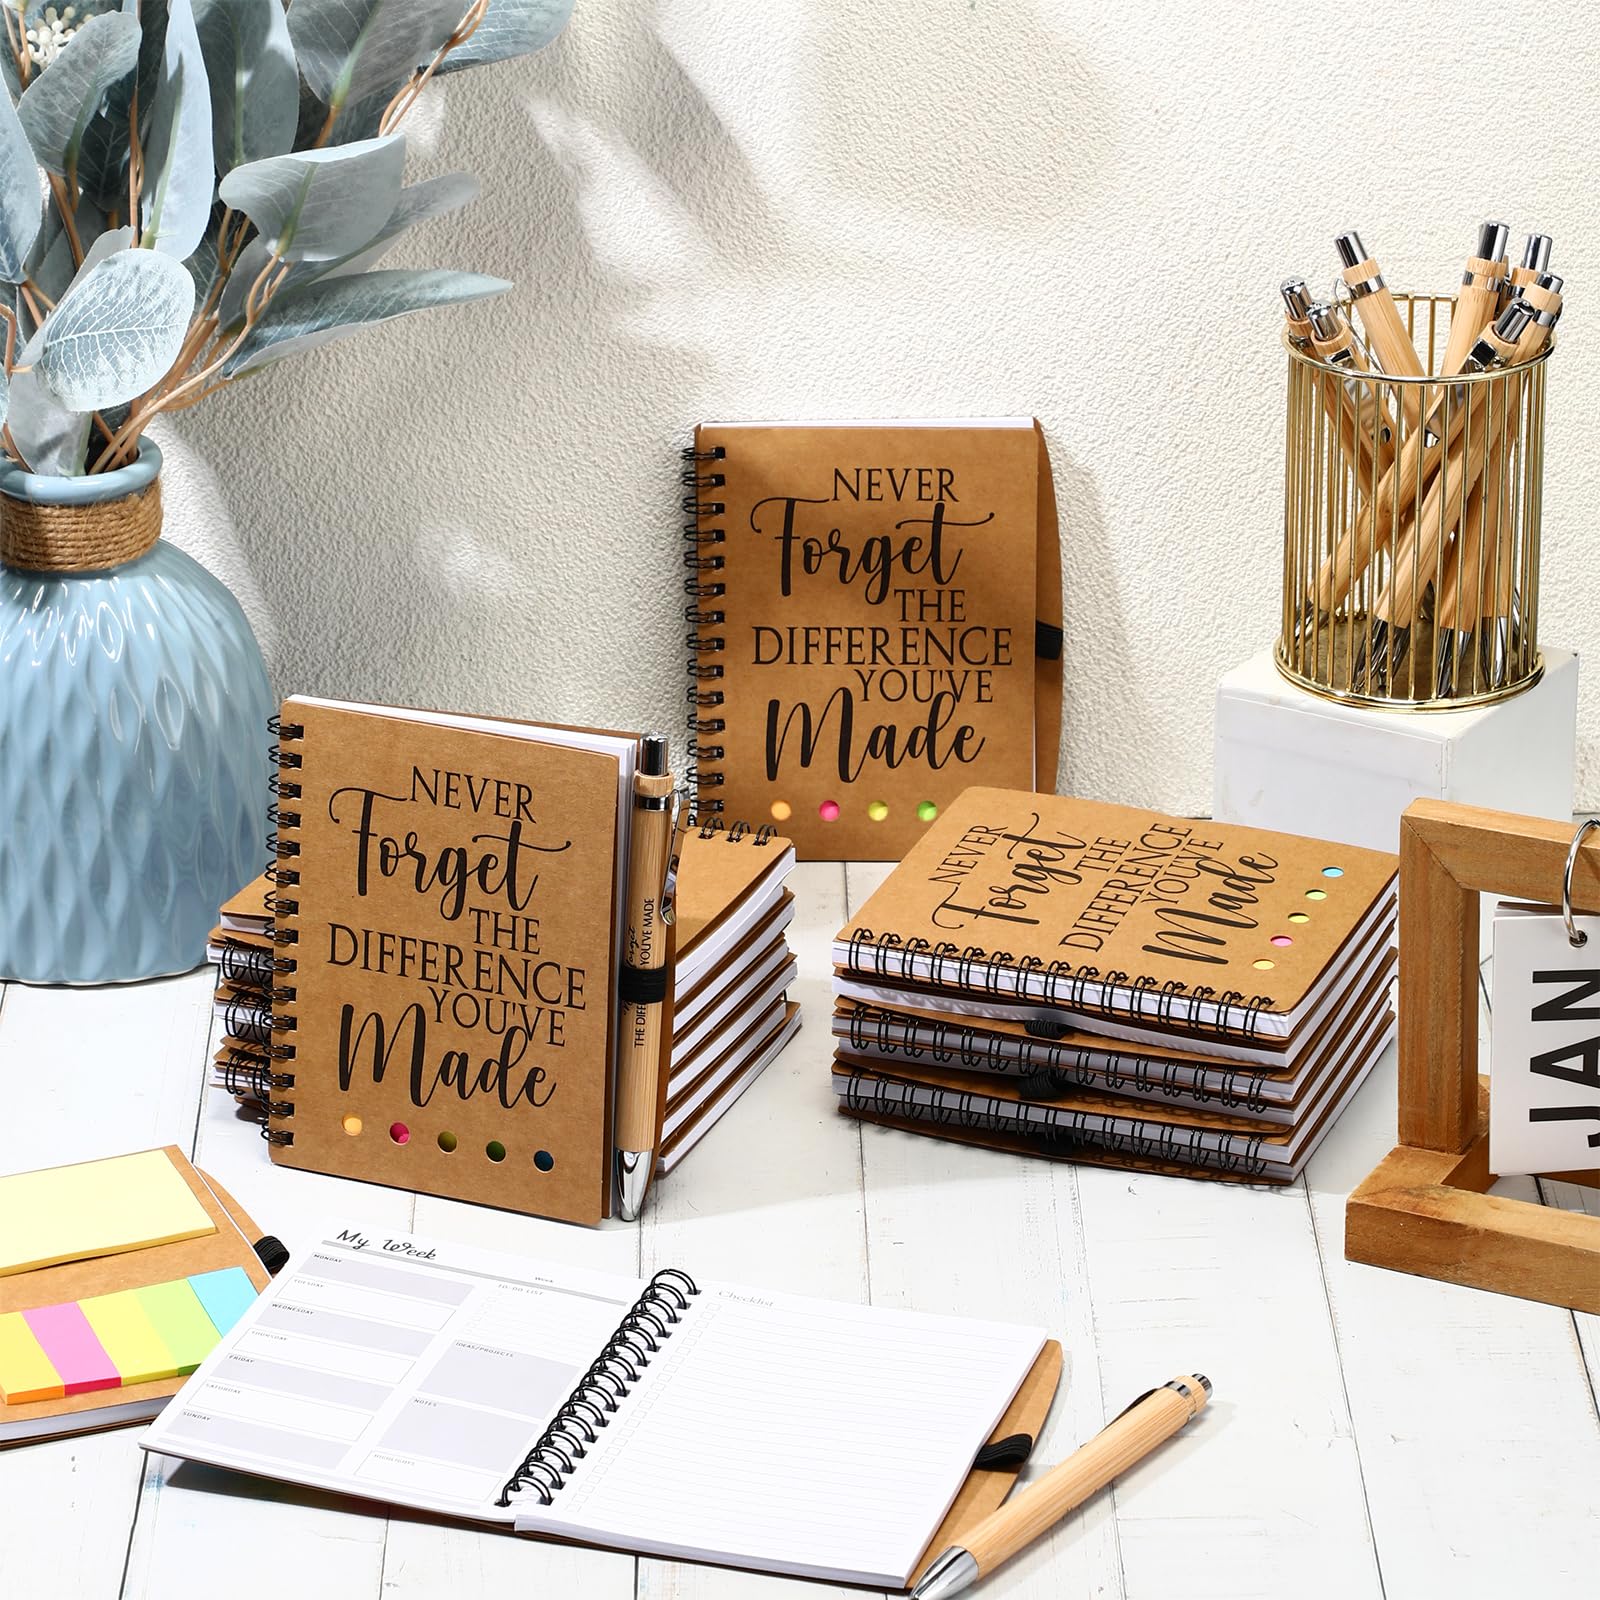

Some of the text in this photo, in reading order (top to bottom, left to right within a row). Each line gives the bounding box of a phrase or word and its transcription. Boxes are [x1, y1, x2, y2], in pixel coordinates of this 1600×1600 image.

[831, 468, 959, 502] NEVER
[750, 497, 994, 605] Forget
[894, 589, 967, 622] THE
[752, 626, 1013, 666] DIFFERENCE
[854, 669, 993, 703] YOU'VE
[766, 687, 985, 783] Made
[409, 766, 537, 823] NEVER
[329, 787, 571, 920] Forget
[928, 825, 1008, 885] NEVER
[932, 812, 1087, 929] Forget
[1073, 836, 1132, 872] THE
[1141, 838, 1224, 904] YOU'VE
[1058, 823, 1192, 952] DIFFERENCE
[643, 898, 655, 928] MADE
[1142, 852, 1278, 964] Made
[468, 907, 540, 955] THE
[640, 930, 653, 966] YOU'VE
[328, 923, 587, 1010] DIFFERENCE
[427, 986, 566, 1047] YOU'VE
[339, 1003, 556, 1108] Made
[634, 1028, 645, 1048] THE
[1529, 969, 1600, 1148] JAN
[313, 1254, 342, 1263] MONDAY
[336, 1229, 437, 1260] My Week
[272, 1303, 314, 1315] WEDNESDAY
[229, 1354, 256, 1363] FRIDAY
[455, 1342, 514, 1358] IDEAS/PROJECTS
[183, 1410, 211, 1421] SUNDAY
[413, 1398, 438, 1407] NOTES
